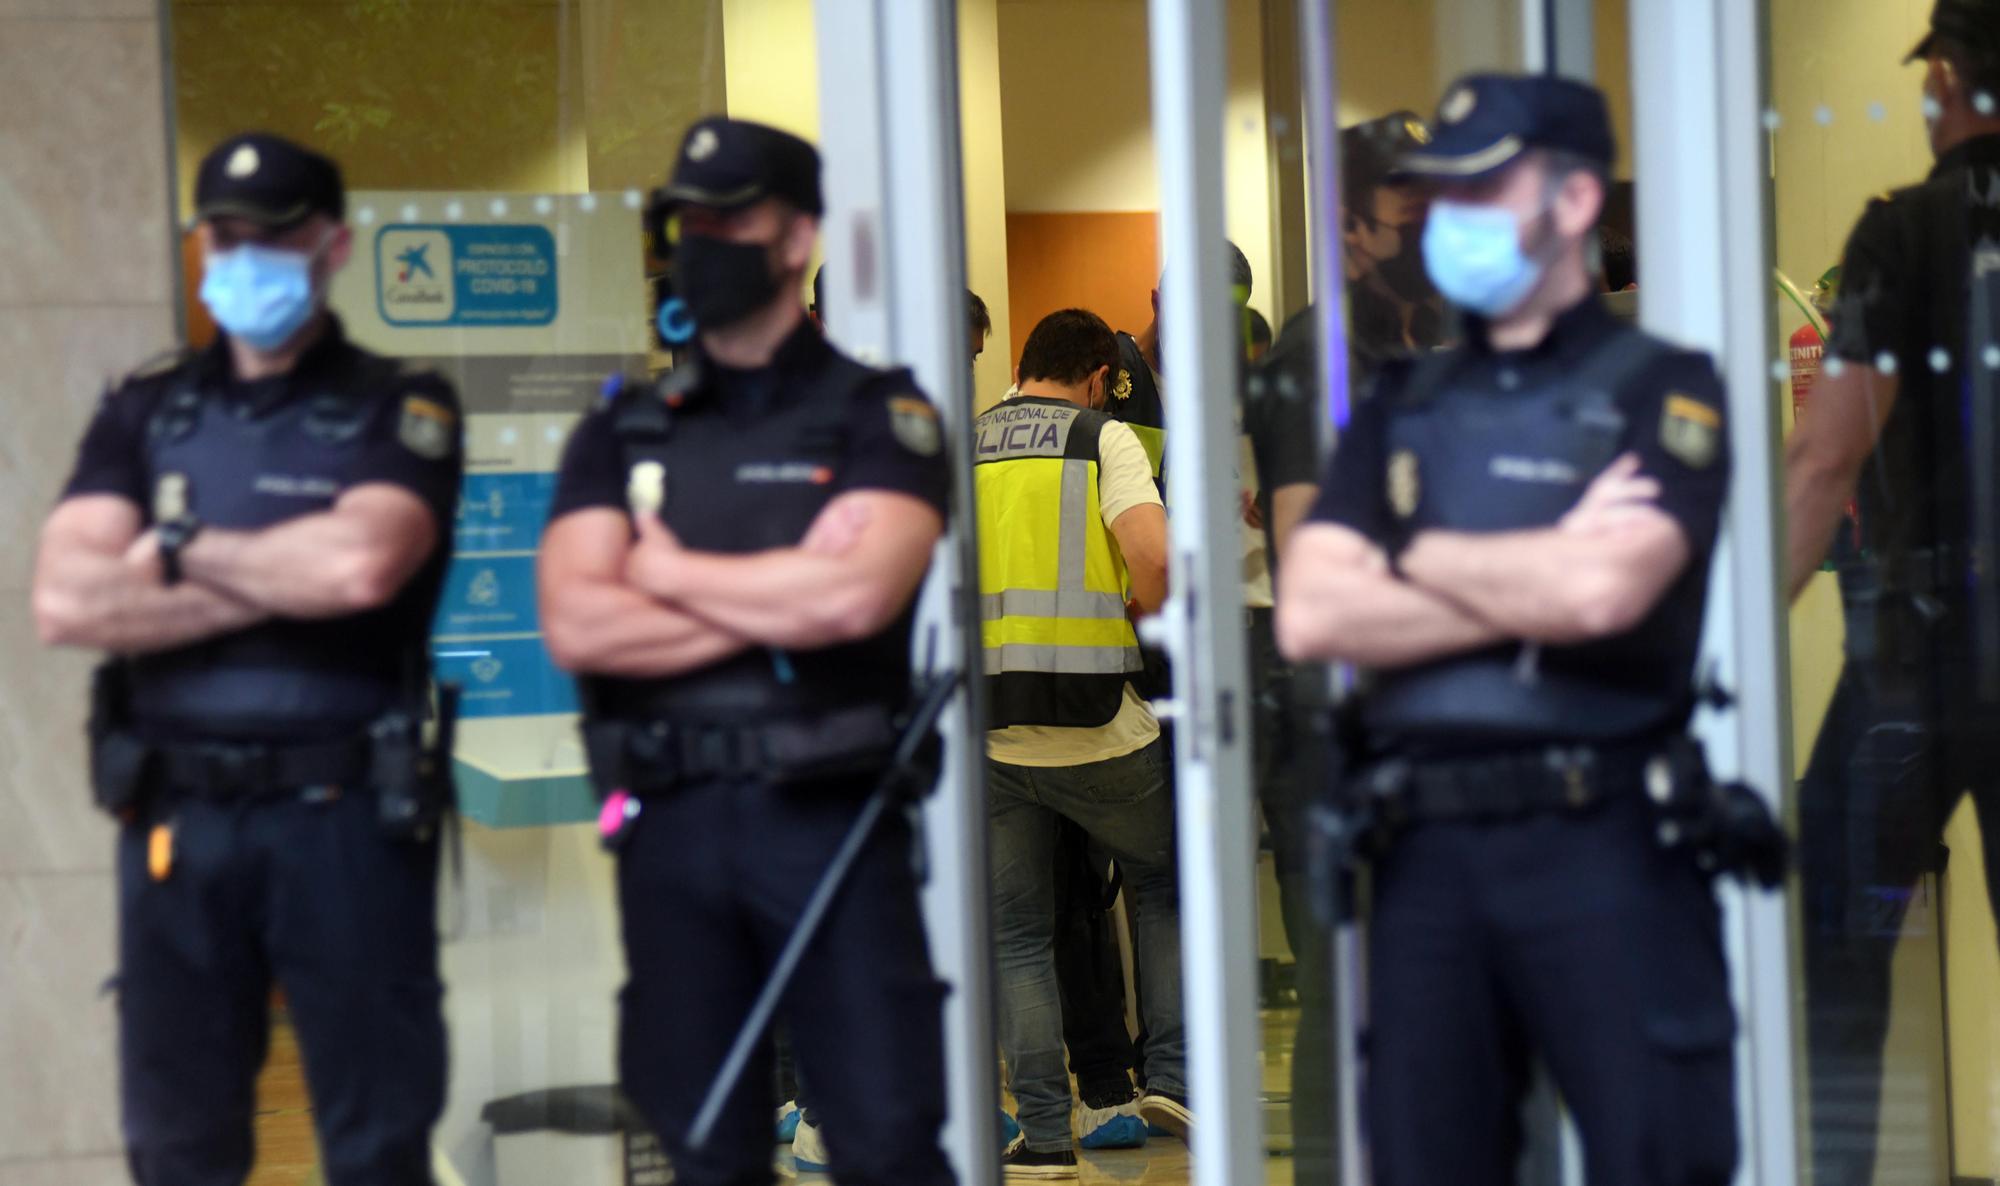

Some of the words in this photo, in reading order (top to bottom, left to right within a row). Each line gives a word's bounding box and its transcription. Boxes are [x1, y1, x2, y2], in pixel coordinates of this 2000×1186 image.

[992, 408, 1048, 424] NACIONAL
[1052, 409, 1072, 419] DE
[975, 423, 1058, 454] LICIA
